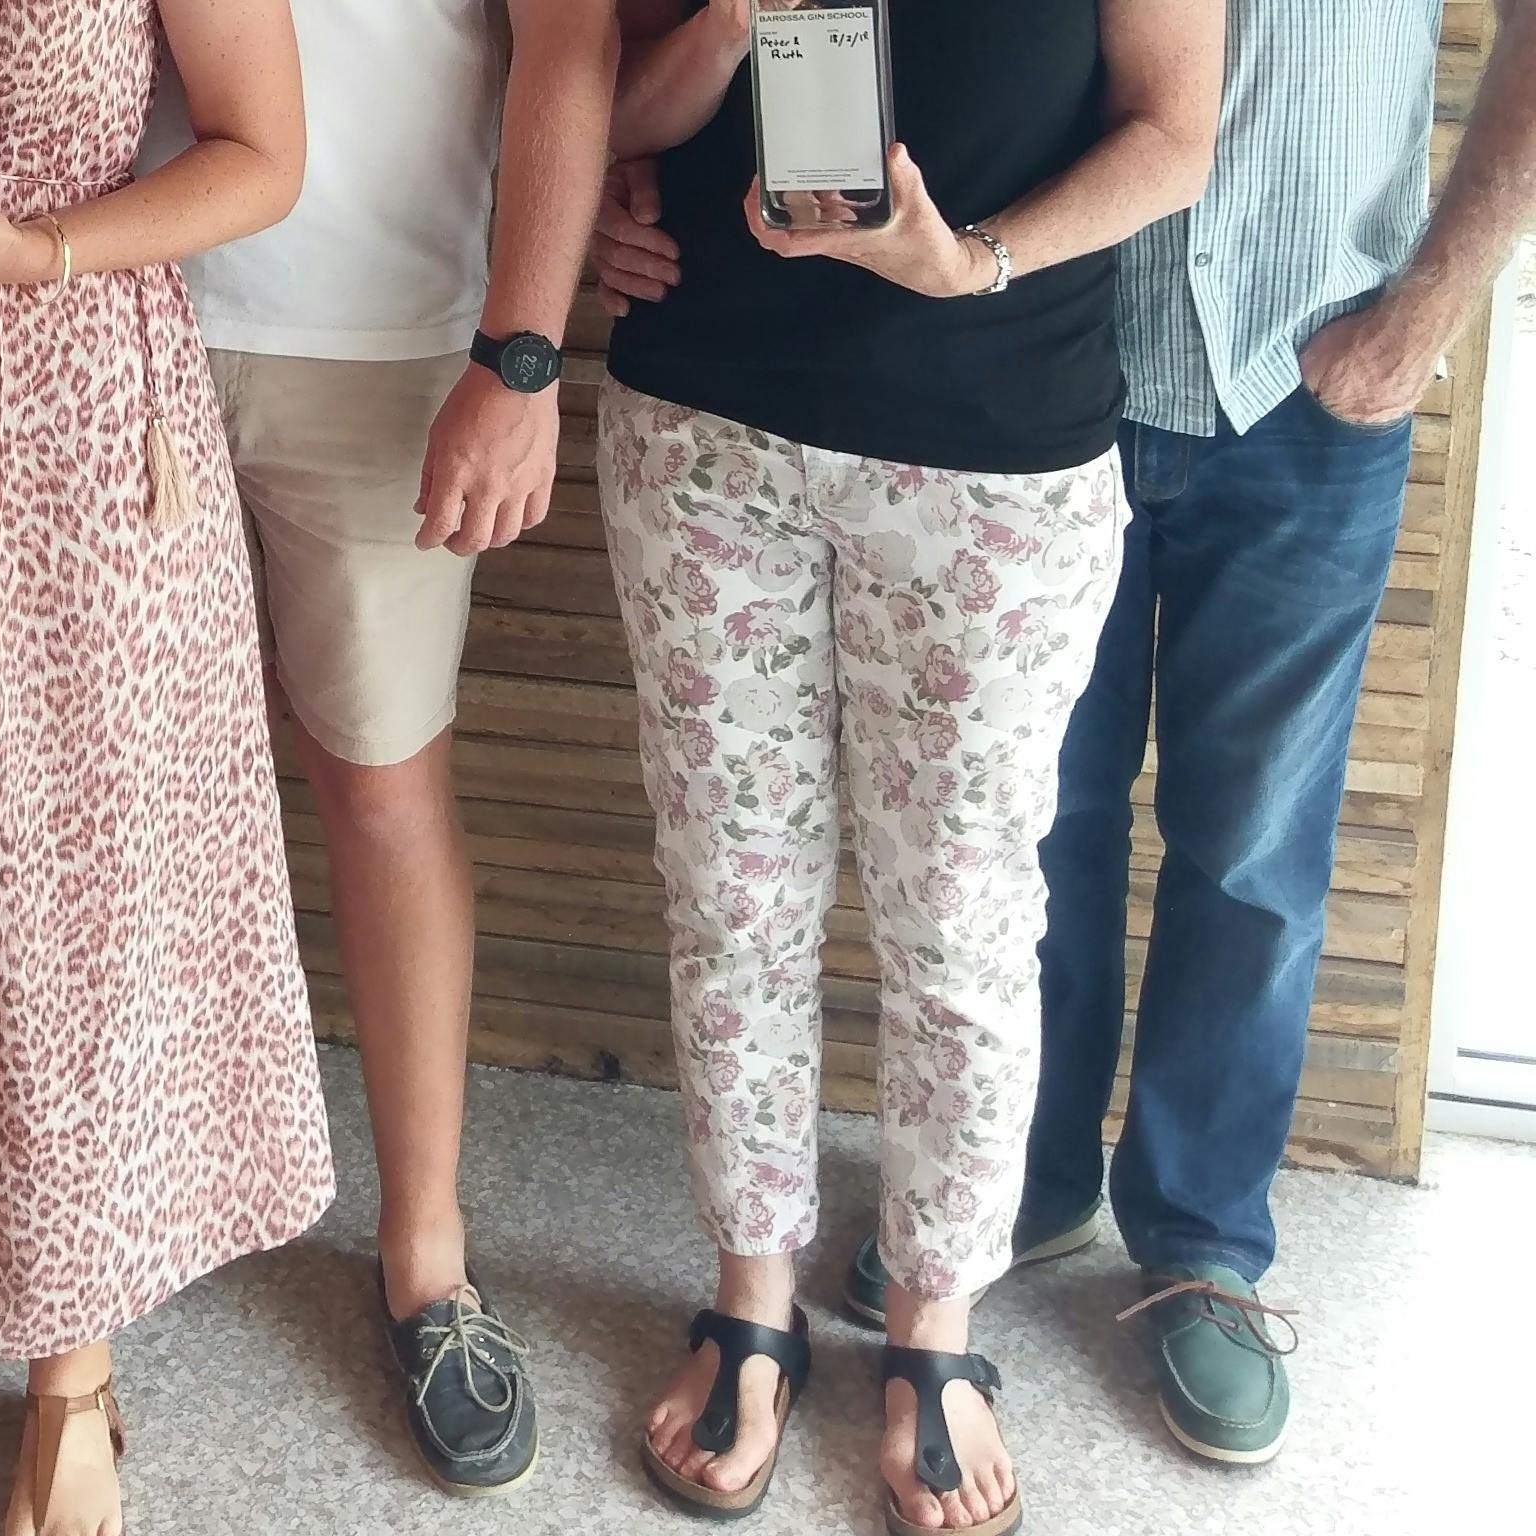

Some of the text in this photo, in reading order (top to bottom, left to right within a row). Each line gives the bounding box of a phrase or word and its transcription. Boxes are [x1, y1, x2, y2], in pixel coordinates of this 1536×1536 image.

[759, 11, 868, 22] BAROSSA GIN SCHOOL
[771, 49, 804, 60] Ruth
